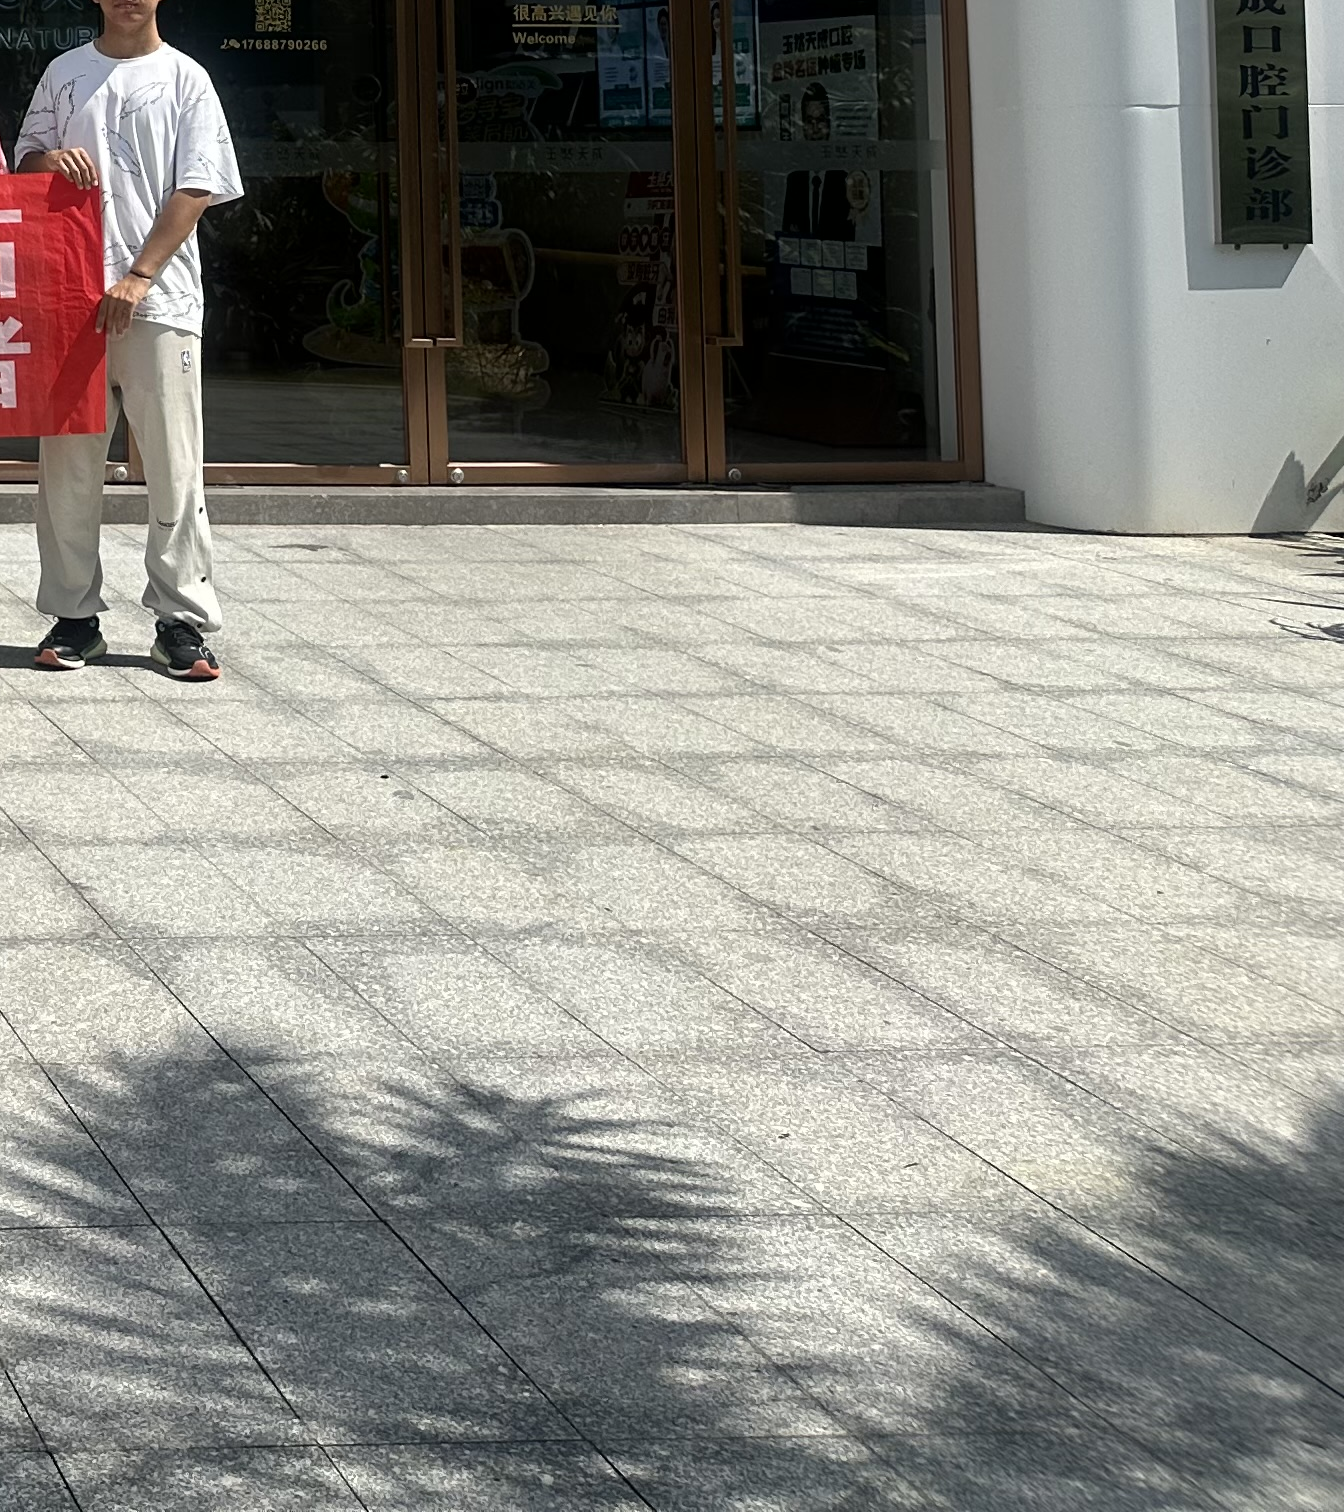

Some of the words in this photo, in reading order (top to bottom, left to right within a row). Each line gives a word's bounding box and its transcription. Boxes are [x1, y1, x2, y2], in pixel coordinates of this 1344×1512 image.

[513, 4, 617, 22] 很高兴遇见你
[241, 39, 328, 51] 17688790266
[512, 31, 576, 45] Welcome
